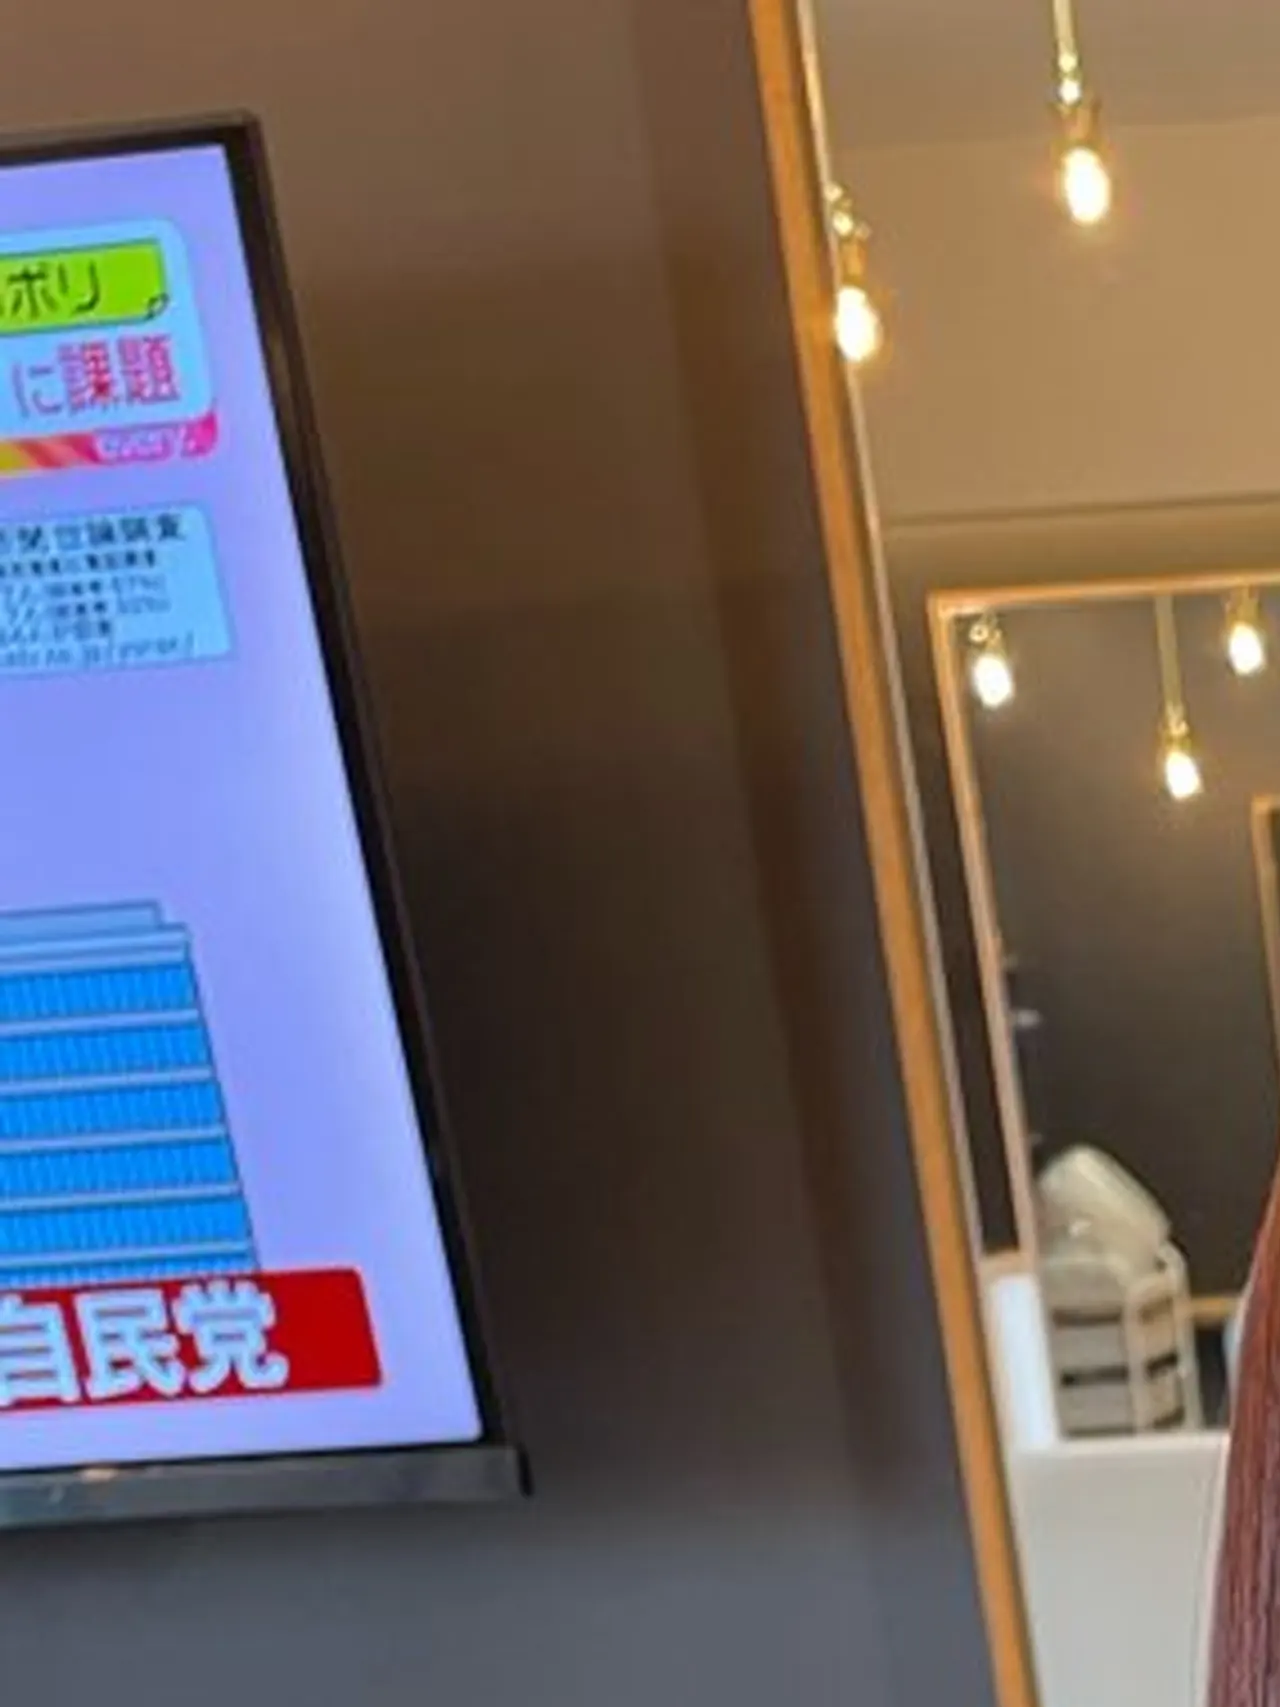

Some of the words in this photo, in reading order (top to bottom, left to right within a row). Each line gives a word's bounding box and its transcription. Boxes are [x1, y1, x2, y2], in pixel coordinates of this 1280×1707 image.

[11, 333, 180, 418] に課題
[0, 1279, 290, 1406] 自民党
